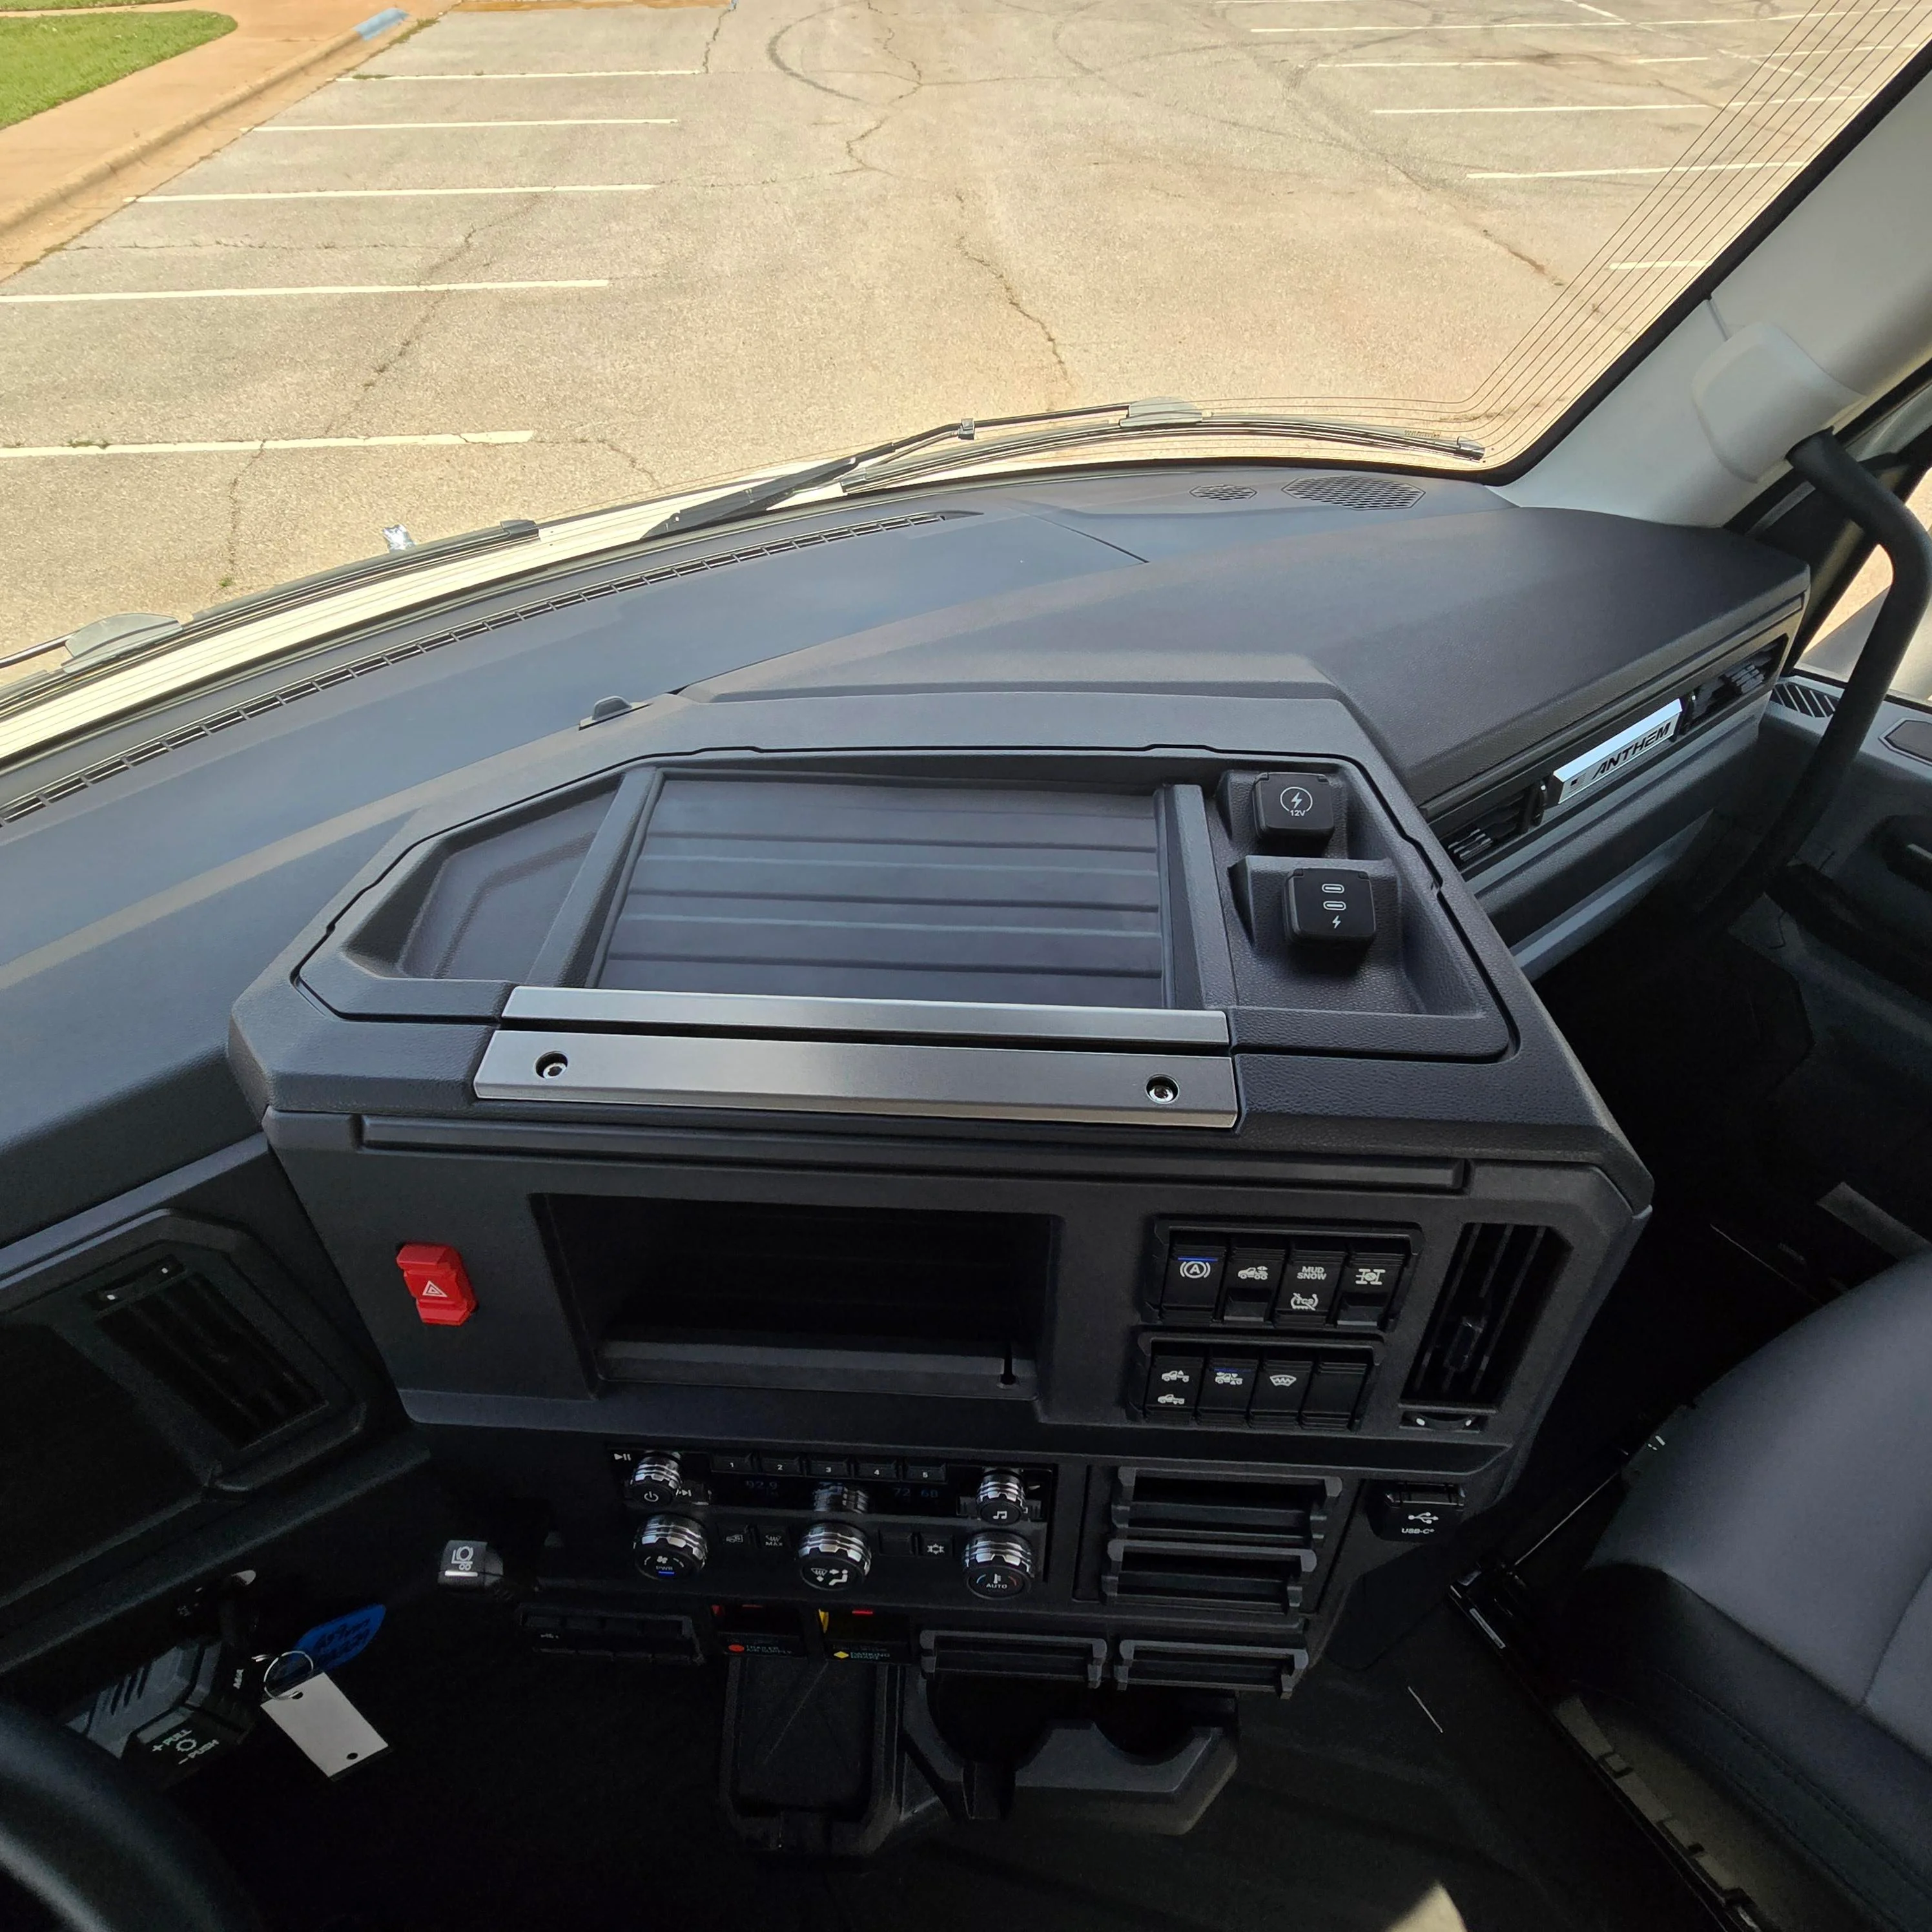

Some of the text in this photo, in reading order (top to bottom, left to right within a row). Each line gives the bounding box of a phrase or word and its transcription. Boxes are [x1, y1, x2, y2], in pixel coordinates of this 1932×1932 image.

[1591, 722, 1671, 780] ANTHEM
[1189, 1264, 1200, 1274] A
[1297, 1272, 1327, 1280] SNOW
